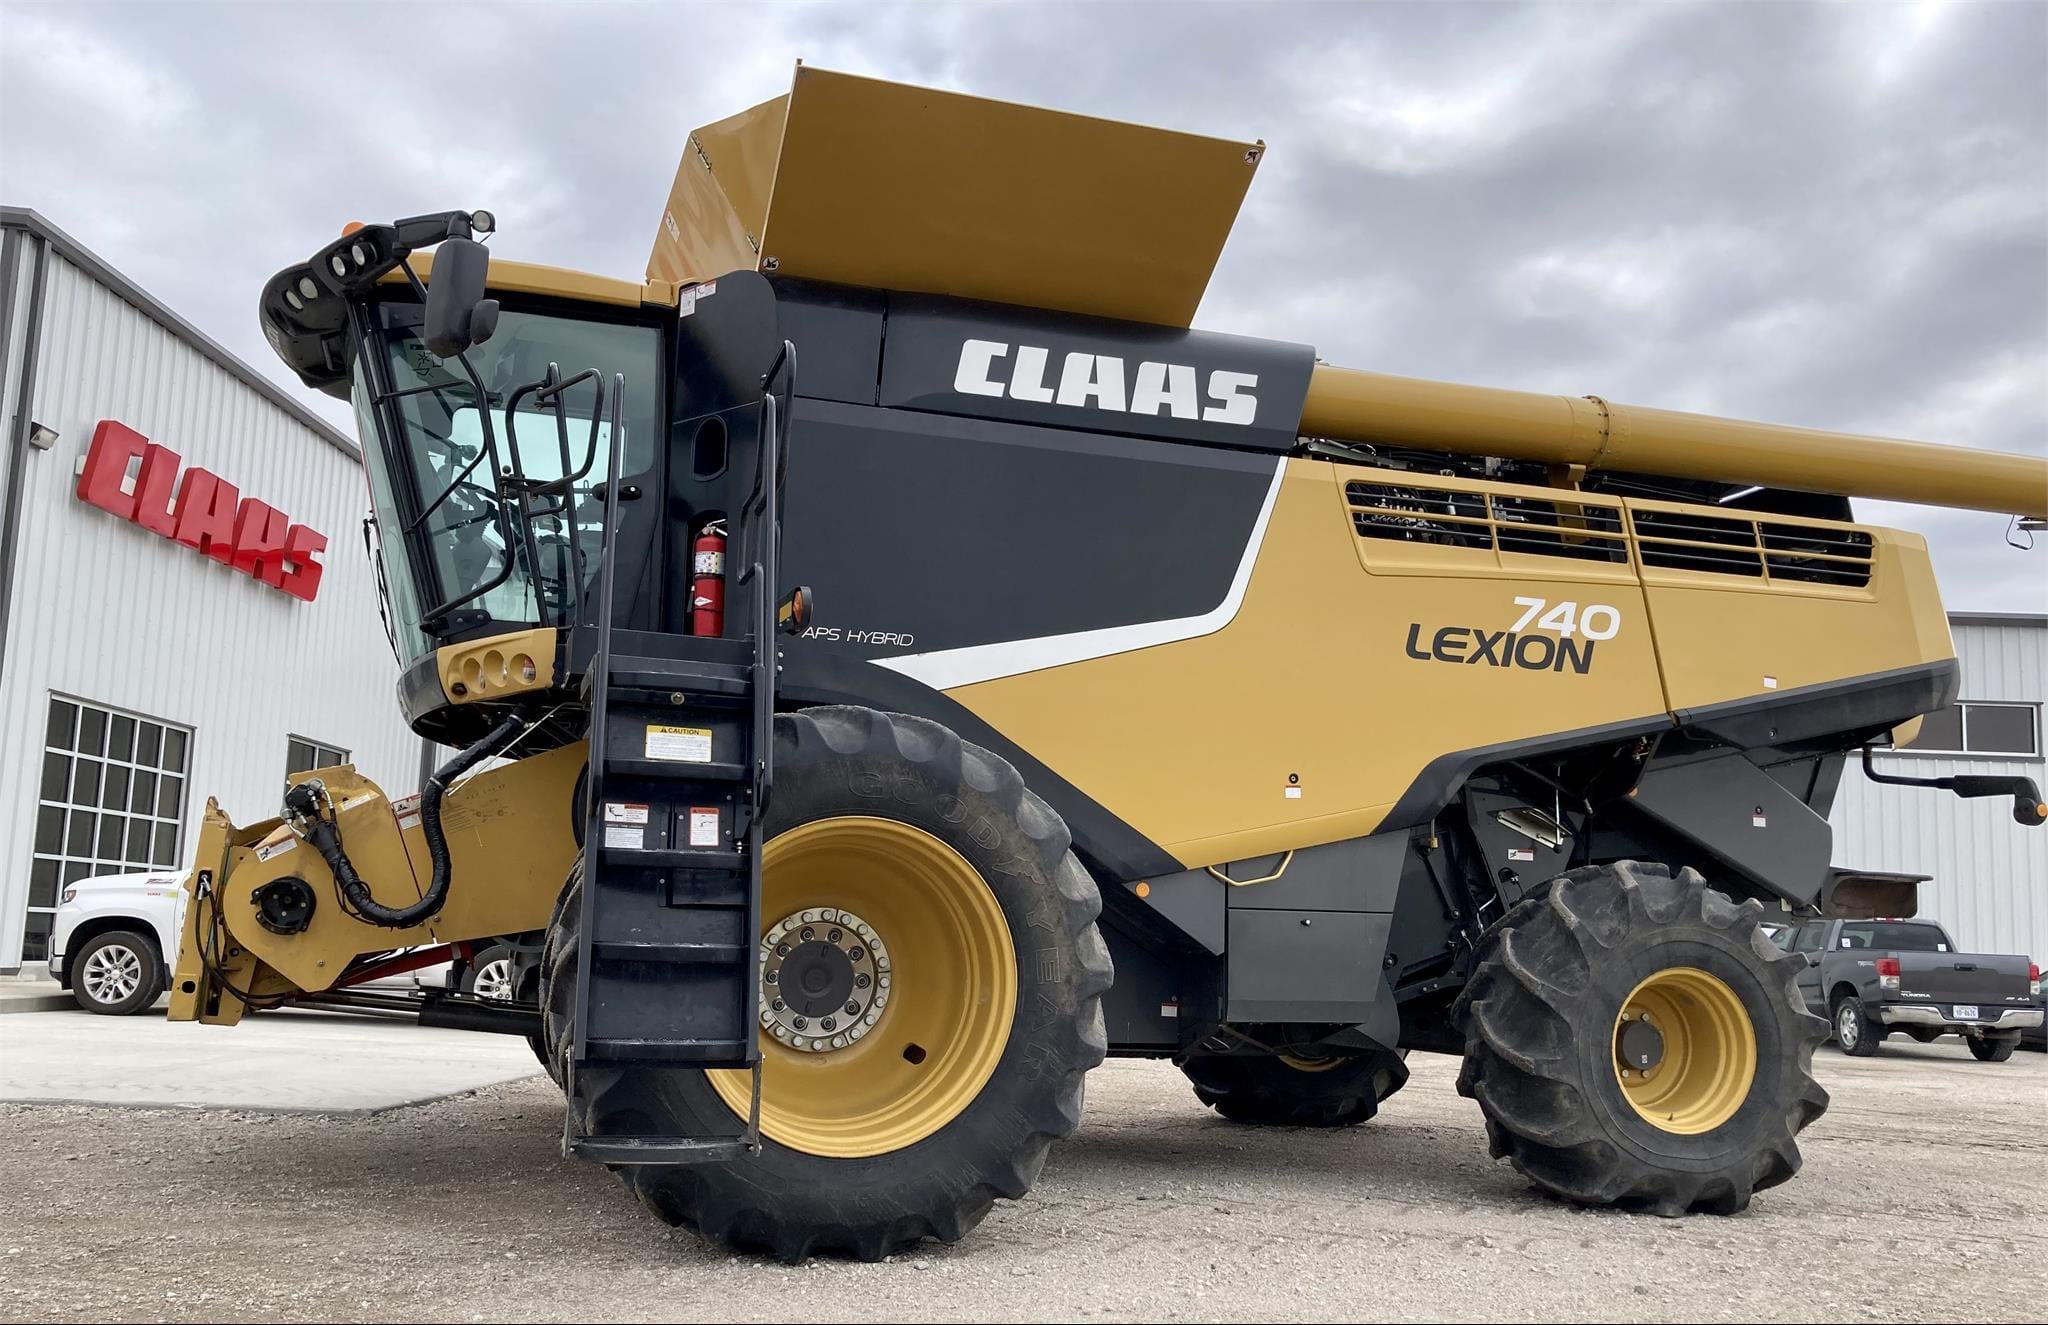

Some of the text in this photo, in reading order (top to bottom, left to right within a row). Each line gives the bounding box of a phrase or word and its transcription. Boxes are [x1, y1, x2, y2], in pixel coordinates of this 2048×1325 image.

[954, 339, 1258, 426] CLAAS
[77, 420, 328, 602] CLAAS
[801, 626, 914, 647] APS HYBRID
[1510, 596, 1621, 641] 740
[1406, 623, 1594, 674] LEXION
[668, 727, 699, 735] CAUTION
